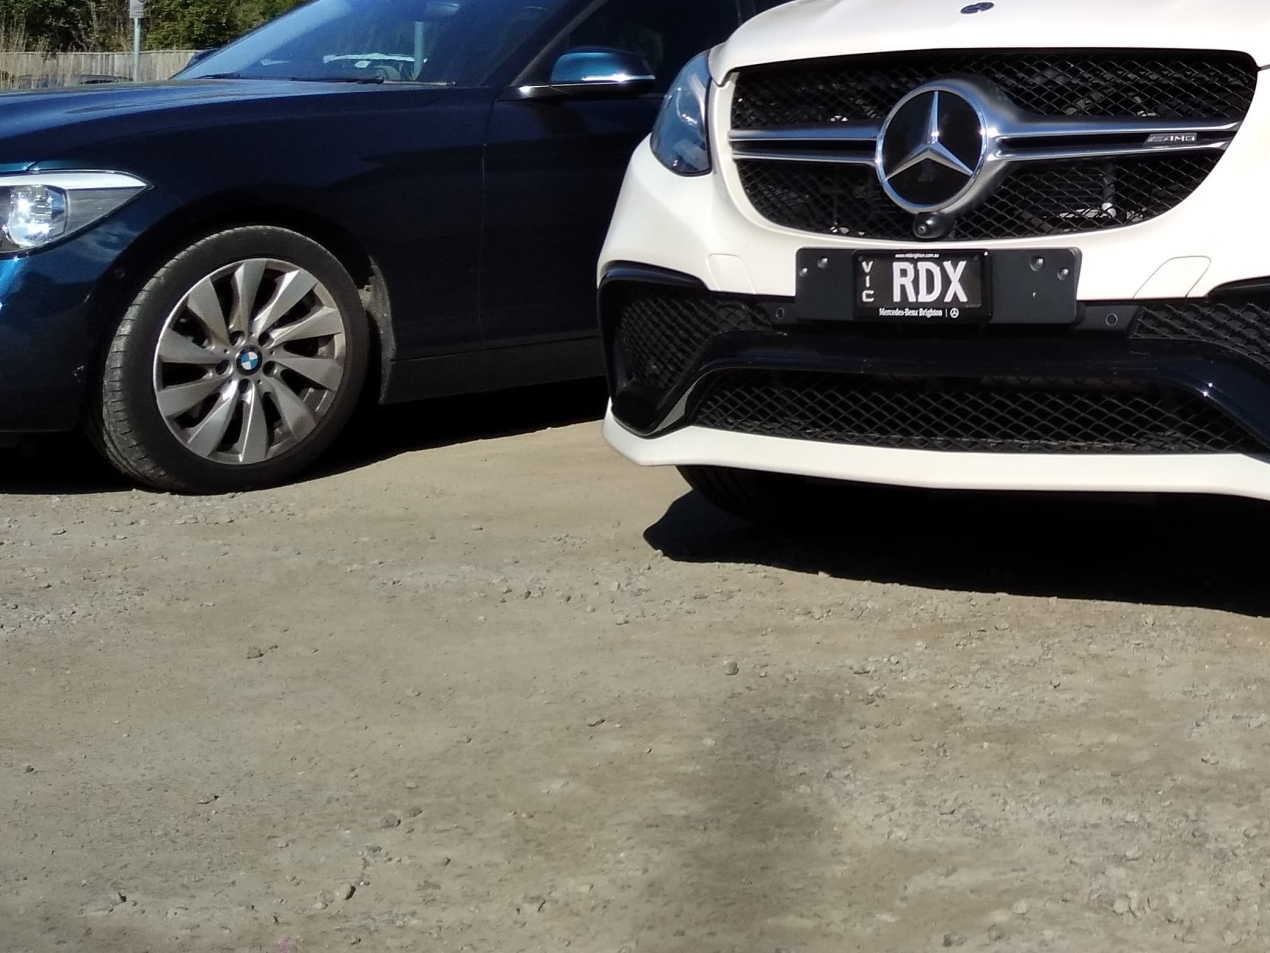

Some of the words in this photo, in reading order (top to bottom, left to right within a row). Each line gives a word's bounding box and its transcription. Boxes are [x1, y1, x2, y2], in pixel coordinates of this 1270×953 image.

[861, 260, 874, 302] VIC
[892, 260, 968, 303] RDX
[878, 308, 918, 317] Mercedes-Benz
[919, 308, 943, 318] Brighton
